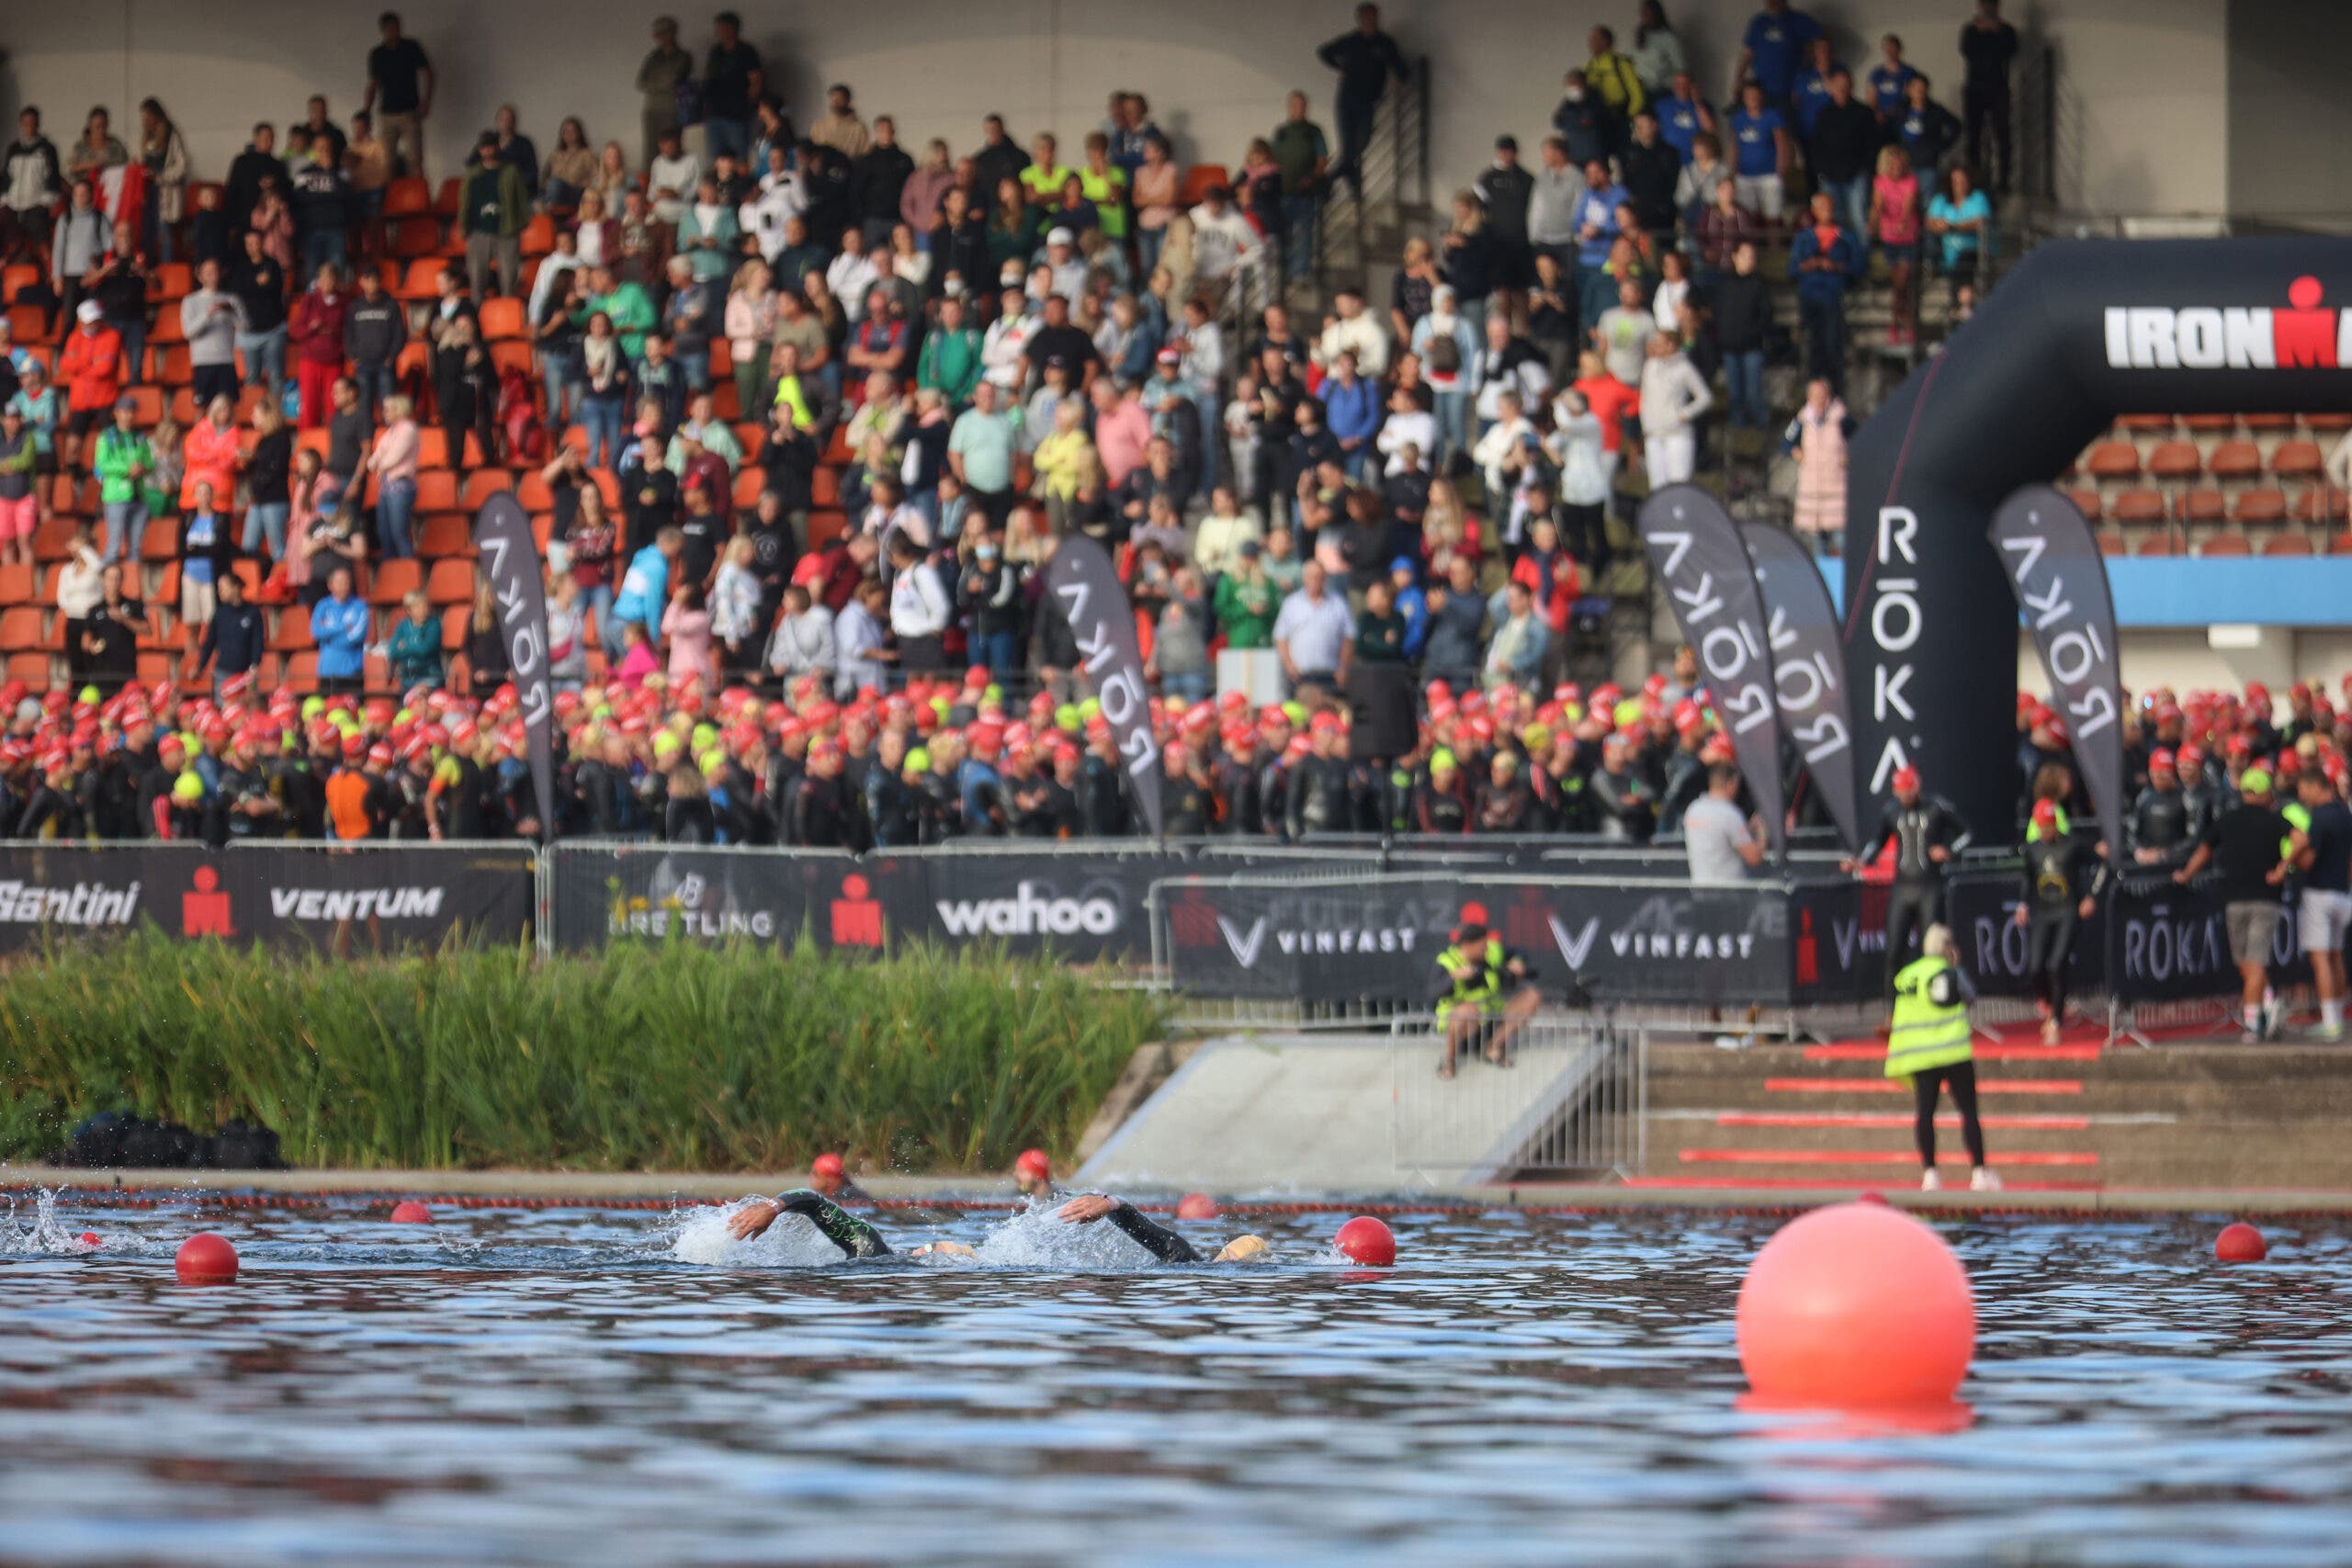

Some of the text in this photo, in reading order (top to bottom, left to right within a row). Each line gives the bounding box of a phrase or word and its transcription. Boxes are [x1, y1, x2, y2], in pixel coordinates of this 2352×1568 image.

[2105, 305, 2352, 368] IRONM
[271, 887, 444, 919] VENTUM
[937, 880, 1118, 935] wahoo
[1277, 928, 1417, 953] VINFAST
[1611, 931, 1755, 959] VINFAST
